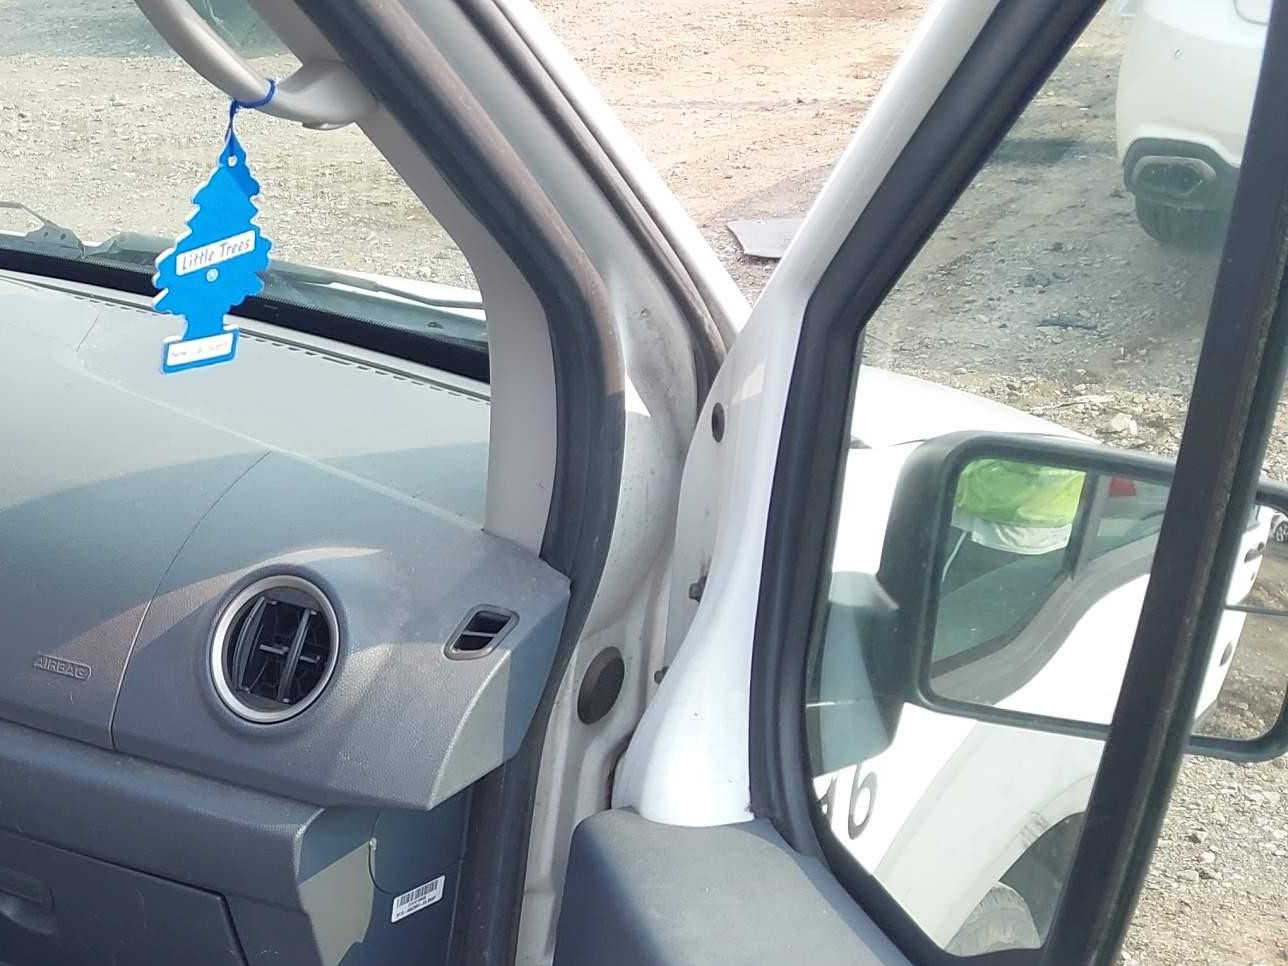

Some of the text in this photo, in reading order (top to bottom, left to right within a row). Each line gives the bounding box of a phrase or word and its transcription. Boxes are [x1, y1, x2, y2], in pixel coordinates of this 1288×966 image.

[182, 239, 250, 271] Little Trees
[33, 657, 87, 679] AIRBAG
